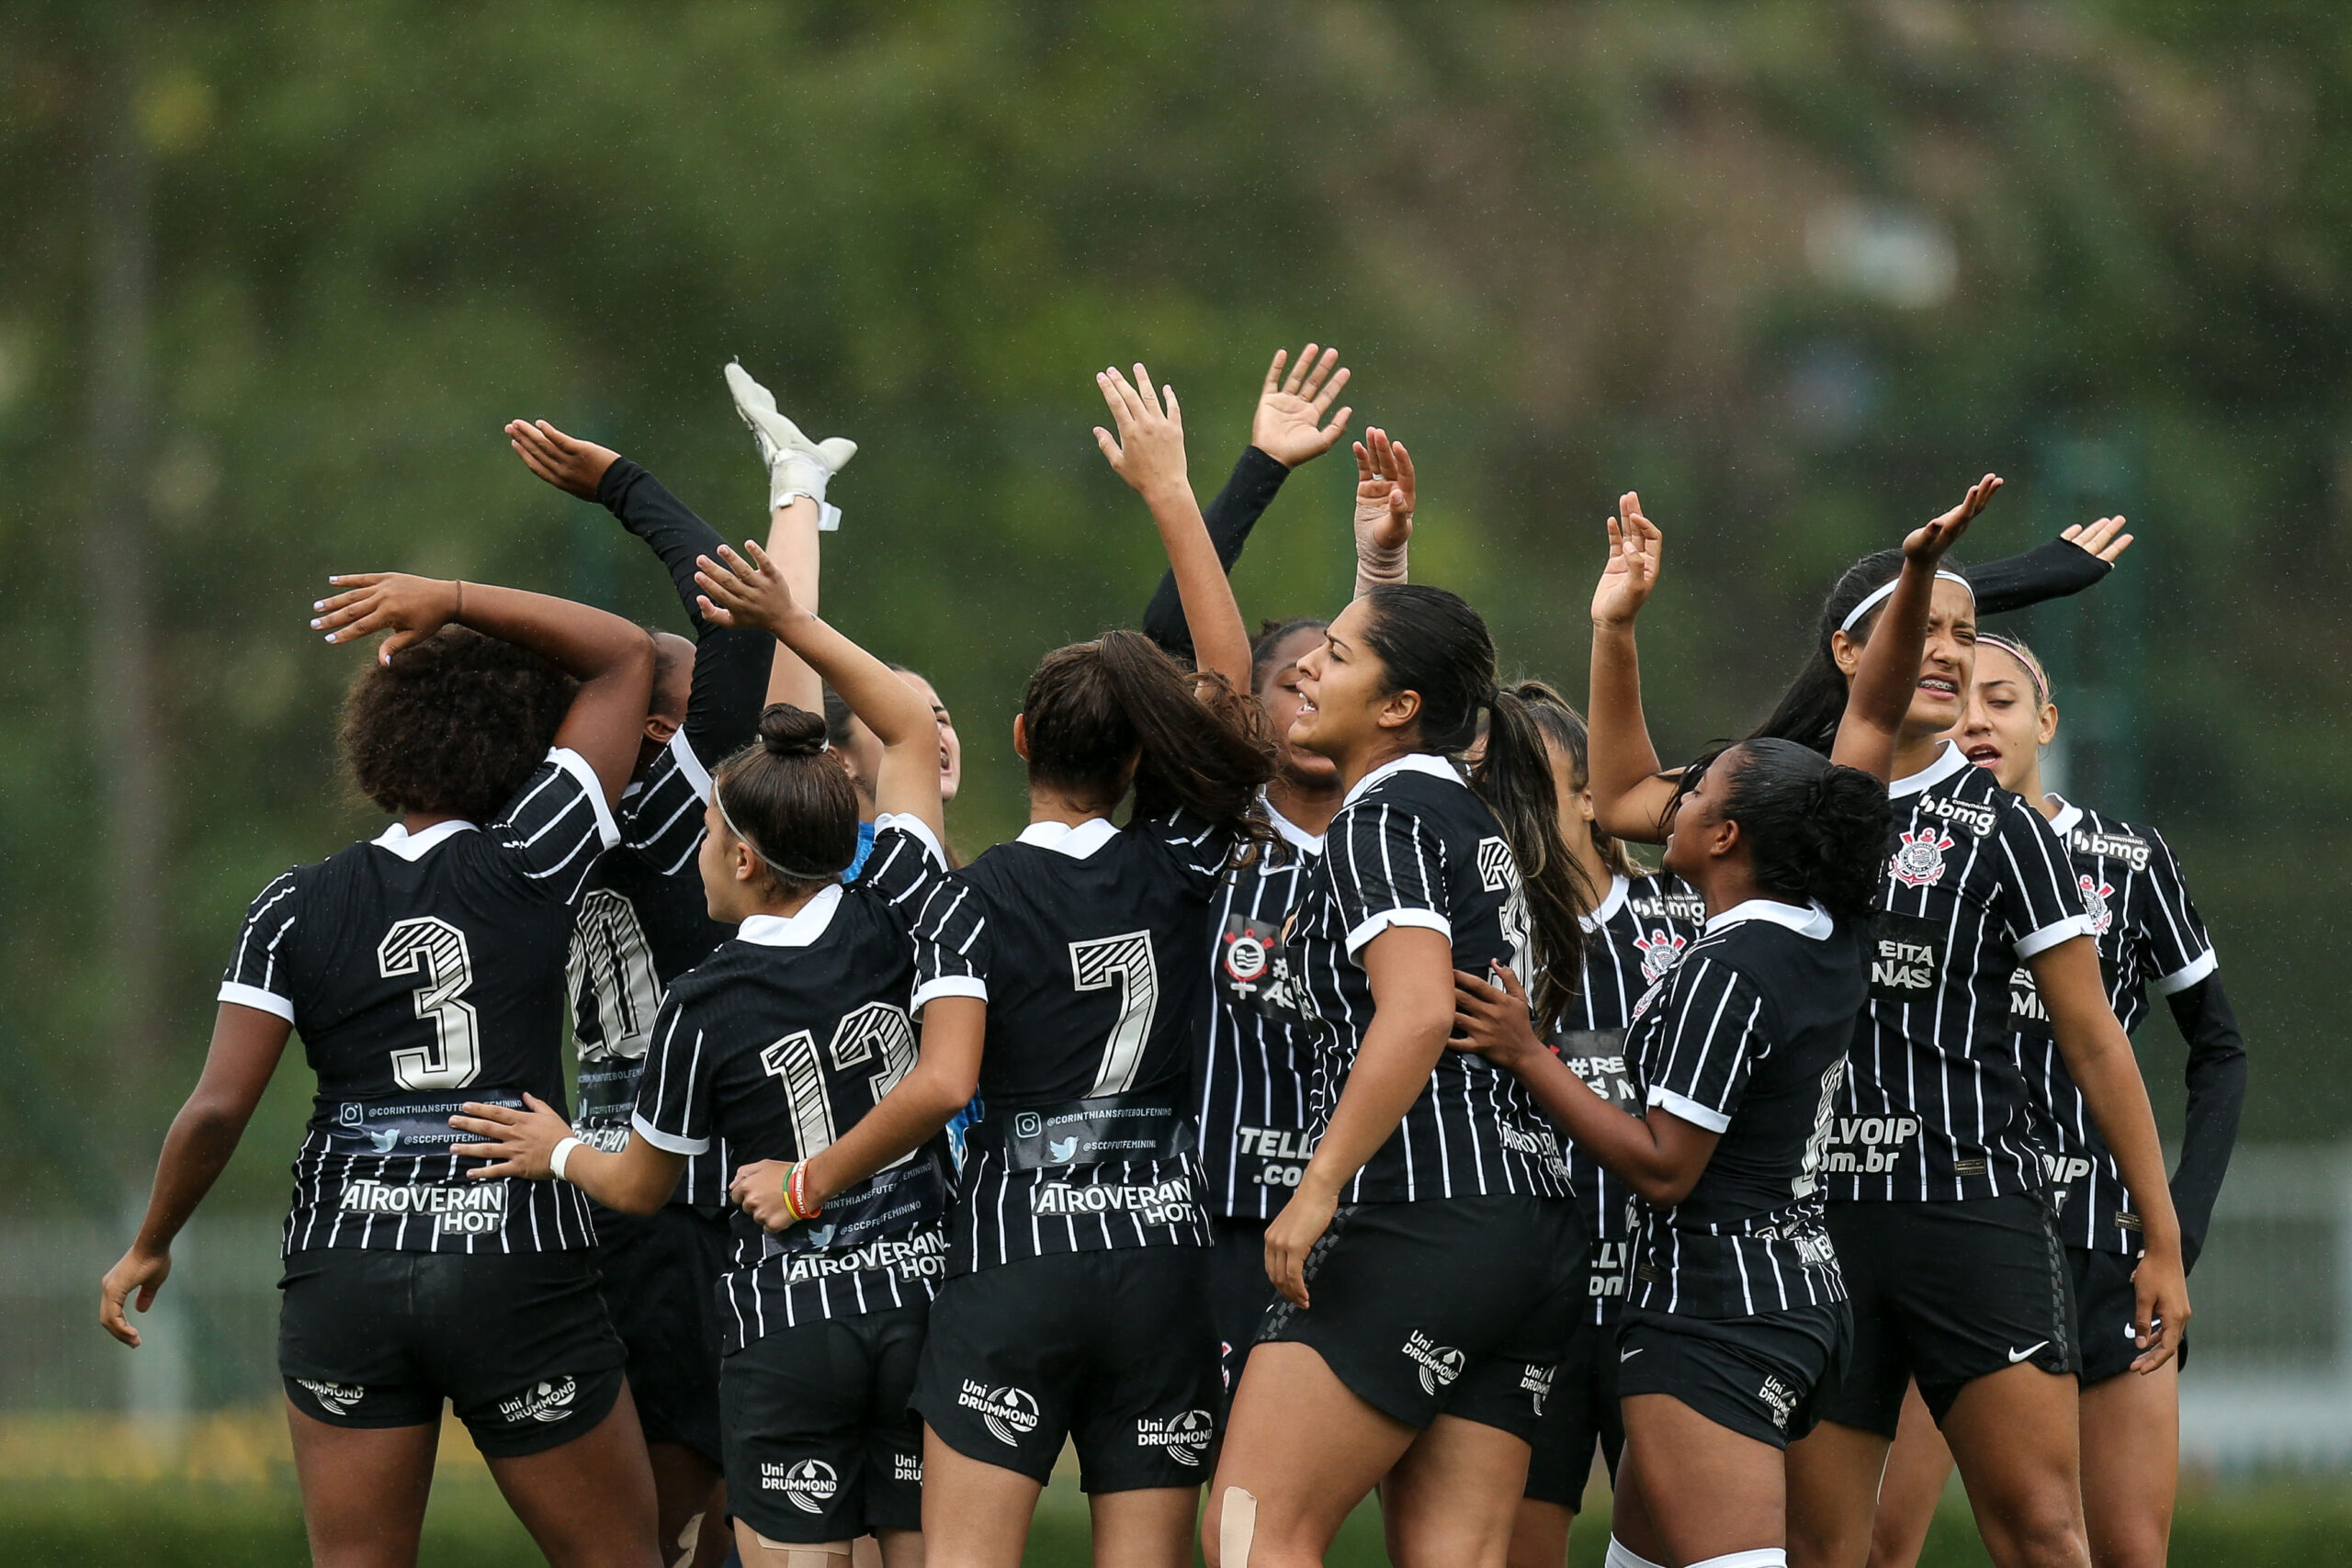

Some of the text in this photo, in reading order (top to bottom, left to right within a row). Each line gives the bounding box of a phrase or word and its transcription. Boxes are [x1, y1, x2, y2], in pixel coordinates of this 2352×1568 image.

[1935, 797, 1996, 836] bmg
[1951, 799, 1992, 812] CORINTHIANS
[2103, 834, 2144, 845] CORINTHIANS
[2091, 834, 2150, 872] bmg
[1879, 940, 1935, 967] EITA
[1871, 960, 1932, 989] NAS
[377, 915, 481, 1091] 3
[1069, 929, 1159, 1100] 7
[2009, 991, 2051, 1021] MI
[760, 1000, 920, 1176] 13
[340, 1179, 503, 1212] ATROVERAN
[1036, 1178, 1193, 1213] ATROVERAN
[444, 1212, 500, 1232] HOT
[1145, 1203, 1193, 1224] HOT
[789, 1230, 945, 1281] ATROVERAN
[899, 1255, 947, 1280] HOT
[1410, 1329, 1434, 1351] Uni
[1401, 1342, 1460, 1382] DRUMMOND
[1525, 1364, 1544, 1380] Uni
[962, 1378, 989, 1398] Uni
[1764, 1374, 1786, 1395] Uni
[499, 1396, 524, 1415] Uni
[505, 1381, 576, 1422] DRUMMOND
[957, 1393, 1038, 1428] DRUMMOND
[1137, 1417, 1163, 1433] Uni
[1137, 1428, 1213, 1447] DRUMMOND
[761, 1462, 784, 1476] Uni
[895, 1453, 917, 1469] Uni
[762, 1477, 837, 1493] DRUMMOND
